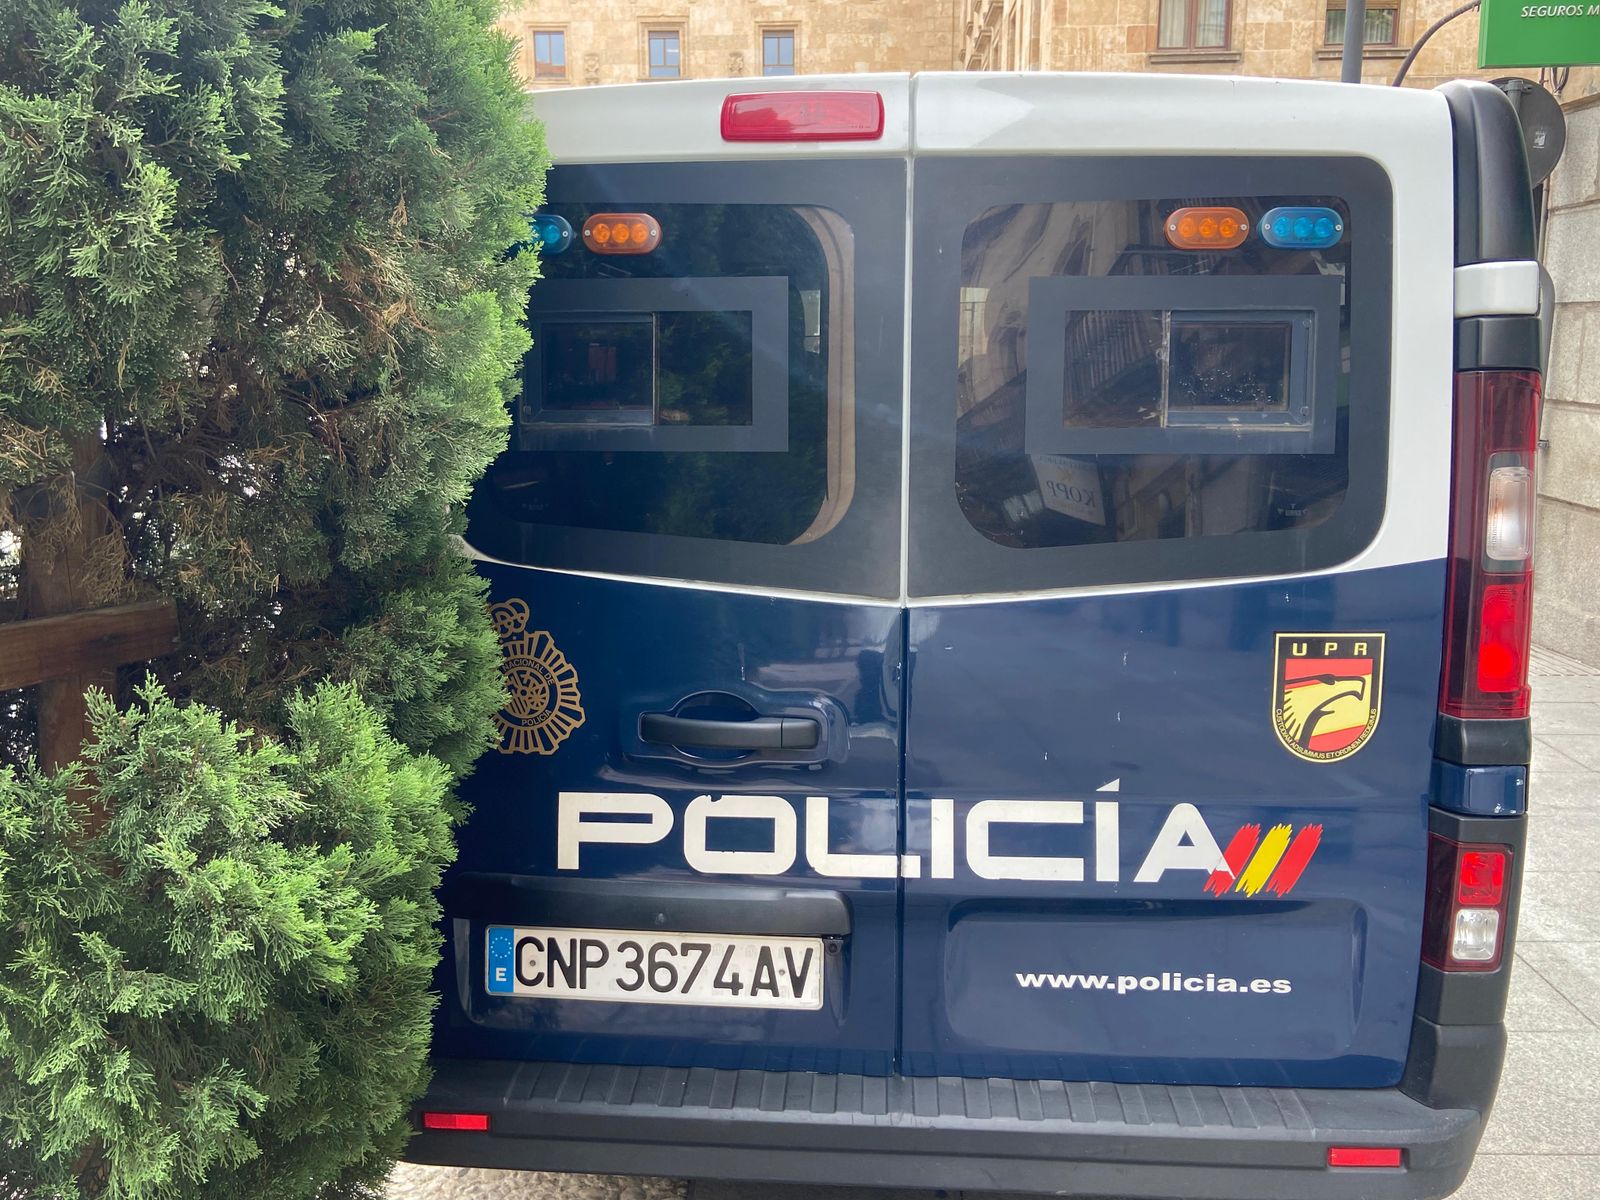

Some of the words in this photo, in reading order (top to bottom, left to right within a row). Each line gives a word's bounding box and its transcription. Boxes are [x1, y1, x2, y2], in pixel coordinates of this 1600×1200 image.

[1521, 5, 1584, 17] SEGUROS
[502, 658, 545, 673] NACIONAL
[544, 673, 554, 686] DE
[557, 778, 1236, 884] POLICÍA
[495, 967, 507, 982] E
[1015, 972, 1292, 995] www.policia.es
